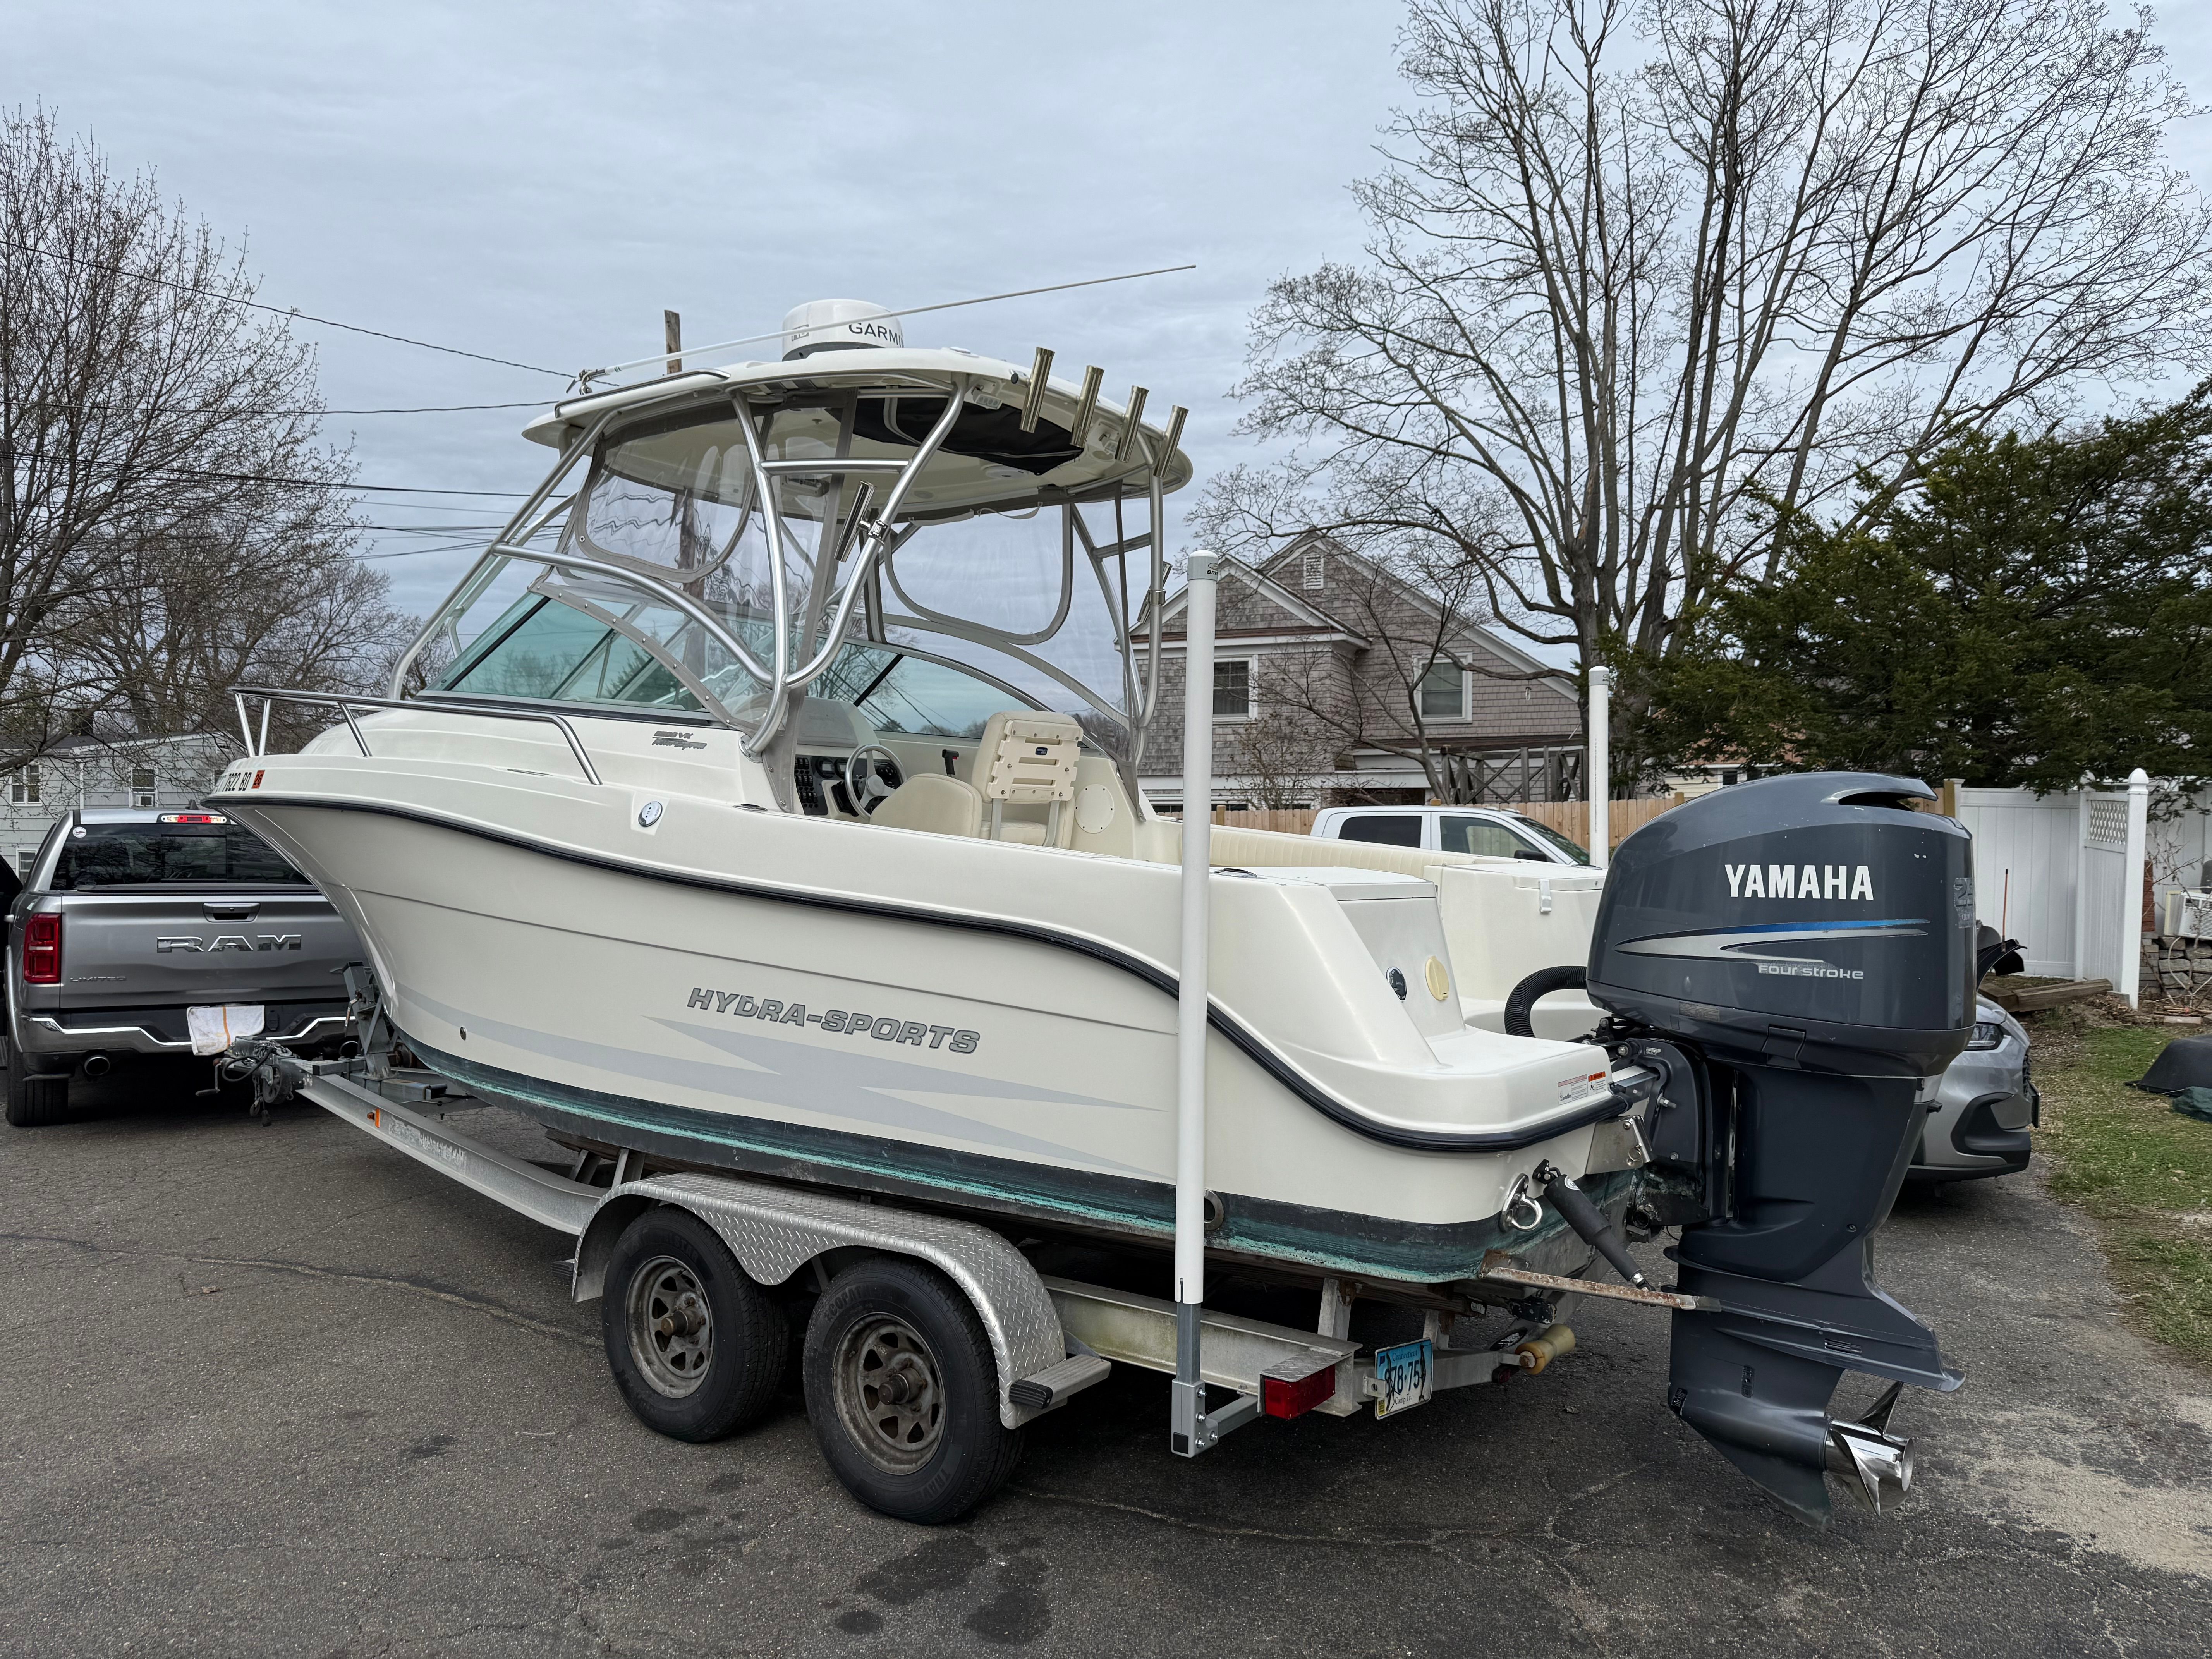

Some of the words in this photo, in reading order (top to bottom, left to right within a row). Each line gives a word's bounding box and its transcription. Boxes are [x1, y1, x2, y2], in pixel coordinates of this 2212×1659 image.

[222, 772, 241, 791] 7622
[253, 774, 263, 785] 26
[1724, 864, 1874, 900] YAMAHA
[157, 934, 302, 953] RAM
[687, 988, 981, 1054] HYDRA-SPORTS
[1392, 1349, 1418, 1362] Connecticut
[1395, 1396, 1406, 1405] Camp
